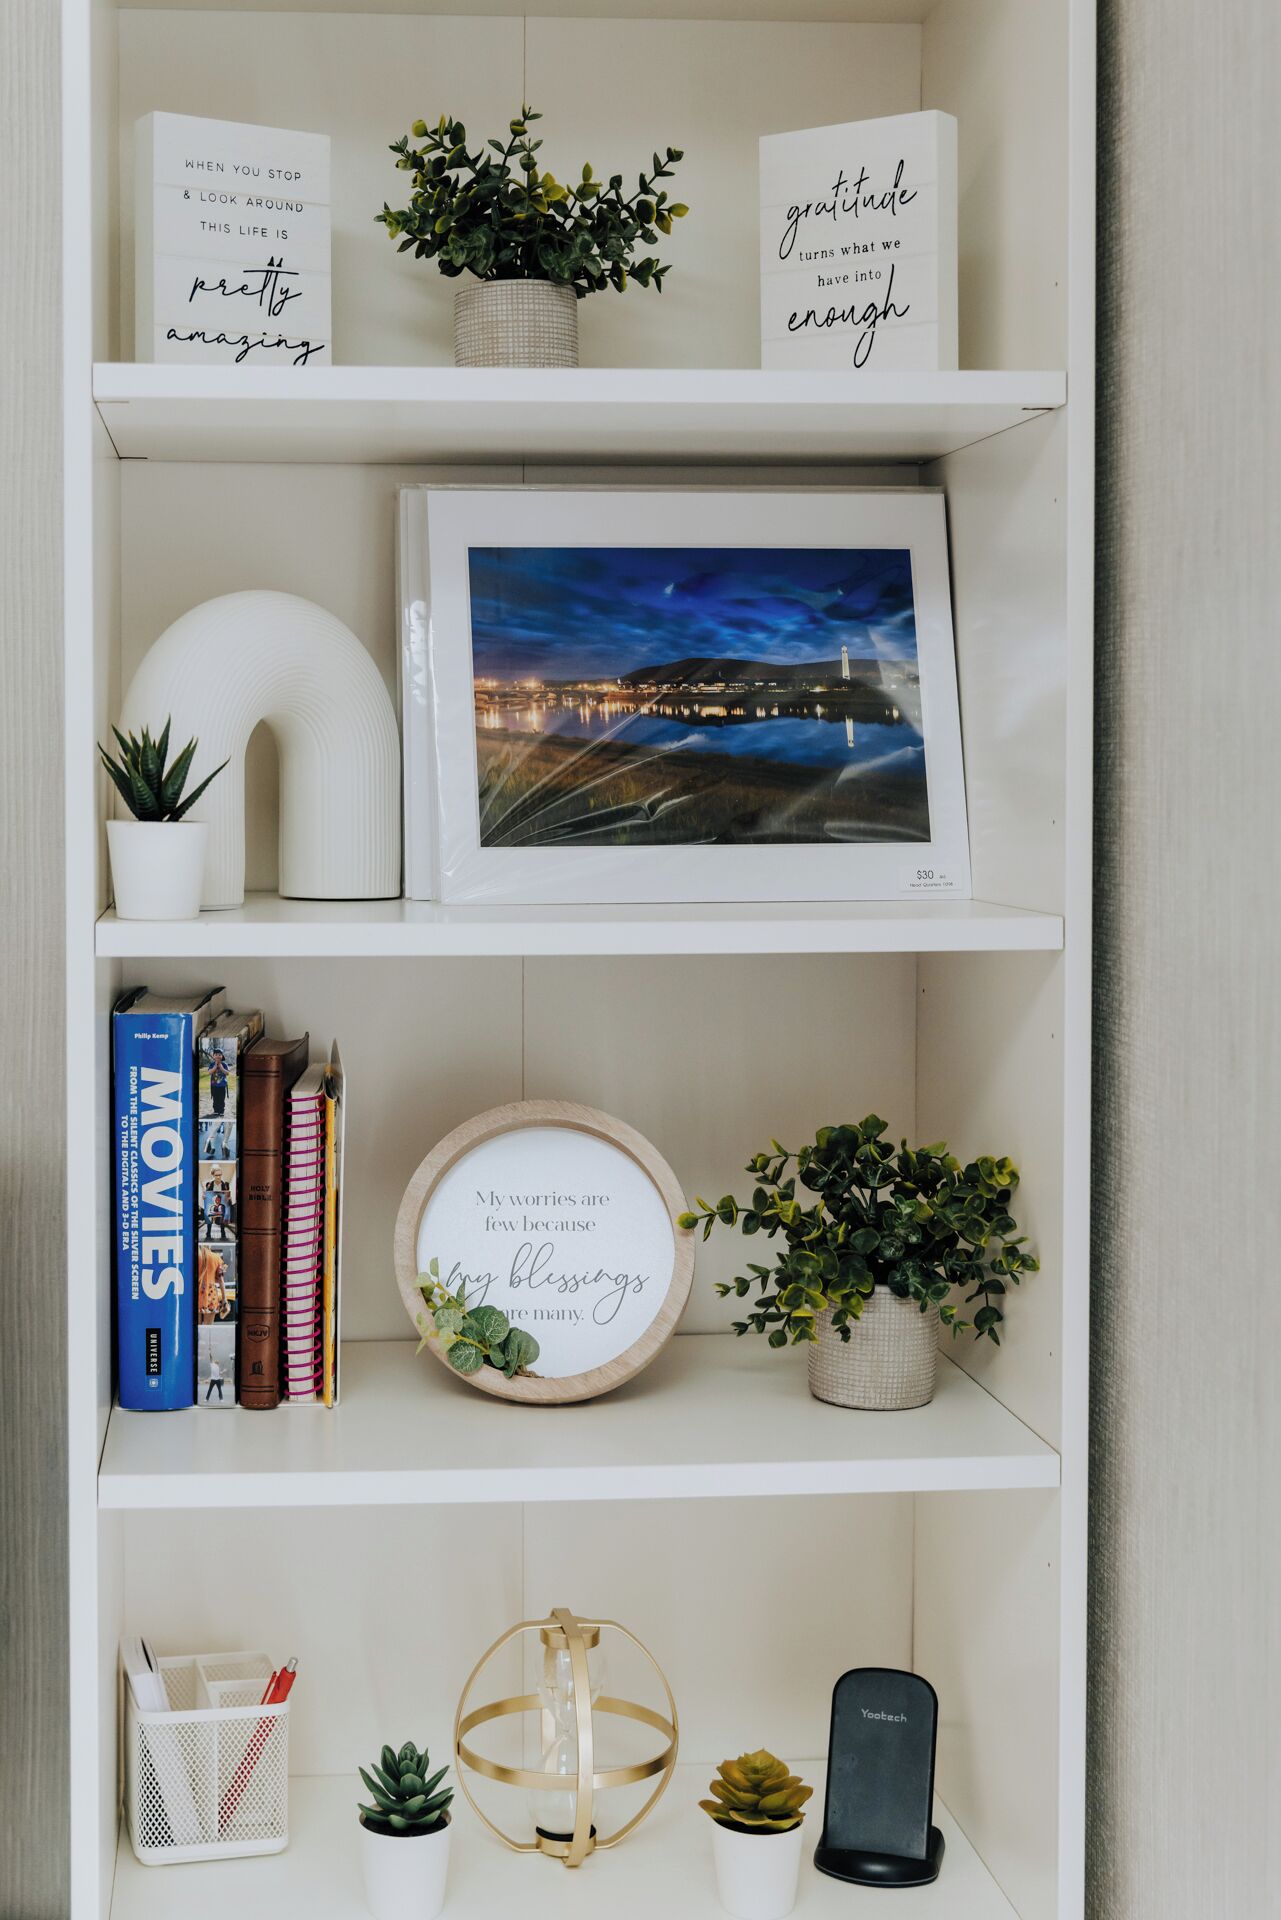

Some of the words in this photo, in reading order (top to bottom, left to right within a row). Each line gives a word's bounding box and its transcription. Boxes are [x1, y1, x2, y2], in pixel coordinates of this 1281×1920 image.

[185, 159, 224, 173] WHEN
[233, 165, 260, 177] YOU
[268, 169, 302, 181] STOP
[183, 190, 191, 200] &
[200, 191, 238, 205] LOOK
[246, 197, 304, 213] AROUND
[779, 159, 918, 260] gratitude
[200, 221, 231, 234] THIS
[239, 225, 268, 238] LIFE
[276, 229, 289, 240] IS
[799, 248, 835, 262] turns
[840, 242, 876, 256] what
[882, 239, 901, 250] we
[189, 256, 302, 317] pretty
[817, 273, 849, 287] have
[855, 269, 882, 282] into
[788, 263, 910, 368] enough
[167, 328, 325, 366] amazing
[916, 870, 934, 880] $30
[130, 1066, 138, 1095] FROM
[130, 1097, 138, 1114] THE
[121, 1115, 129, 1128] TO
[121, 1130, 129, 1149] THE
[130, 1117, 138, 1149] SILENT
[121, 1151, 129, 1187] DIGITAL
[130, 1150, 138, 1193] CLASSICS
[141, 1066, 184, 1300] MOVIES
[131, 1195, 138, 1209] OF
[476, 1190, 507, 1211] My
[508, 1190, 576, 1207] worries
[581, 1194, 610, 1207] are
[122, 1212, 130, 1229] 3-D
[131, 1210, 139, 1228] THE
[485, 1215, 518, 1232] few
[523, 1215, 596, 1232] because
[122, 1231, 130, 1251] ERA
[131, 1230, 139, 1262] SILVER
[131, 1263, 139, 1300] SCREEN
[509, 1242, 650, 1325] blessings
[533, 1307, 585, 1326] many.
[150, 1333, 158, 1373] UNIVERSE
[861, 1708, 907, 1723] Yootech
